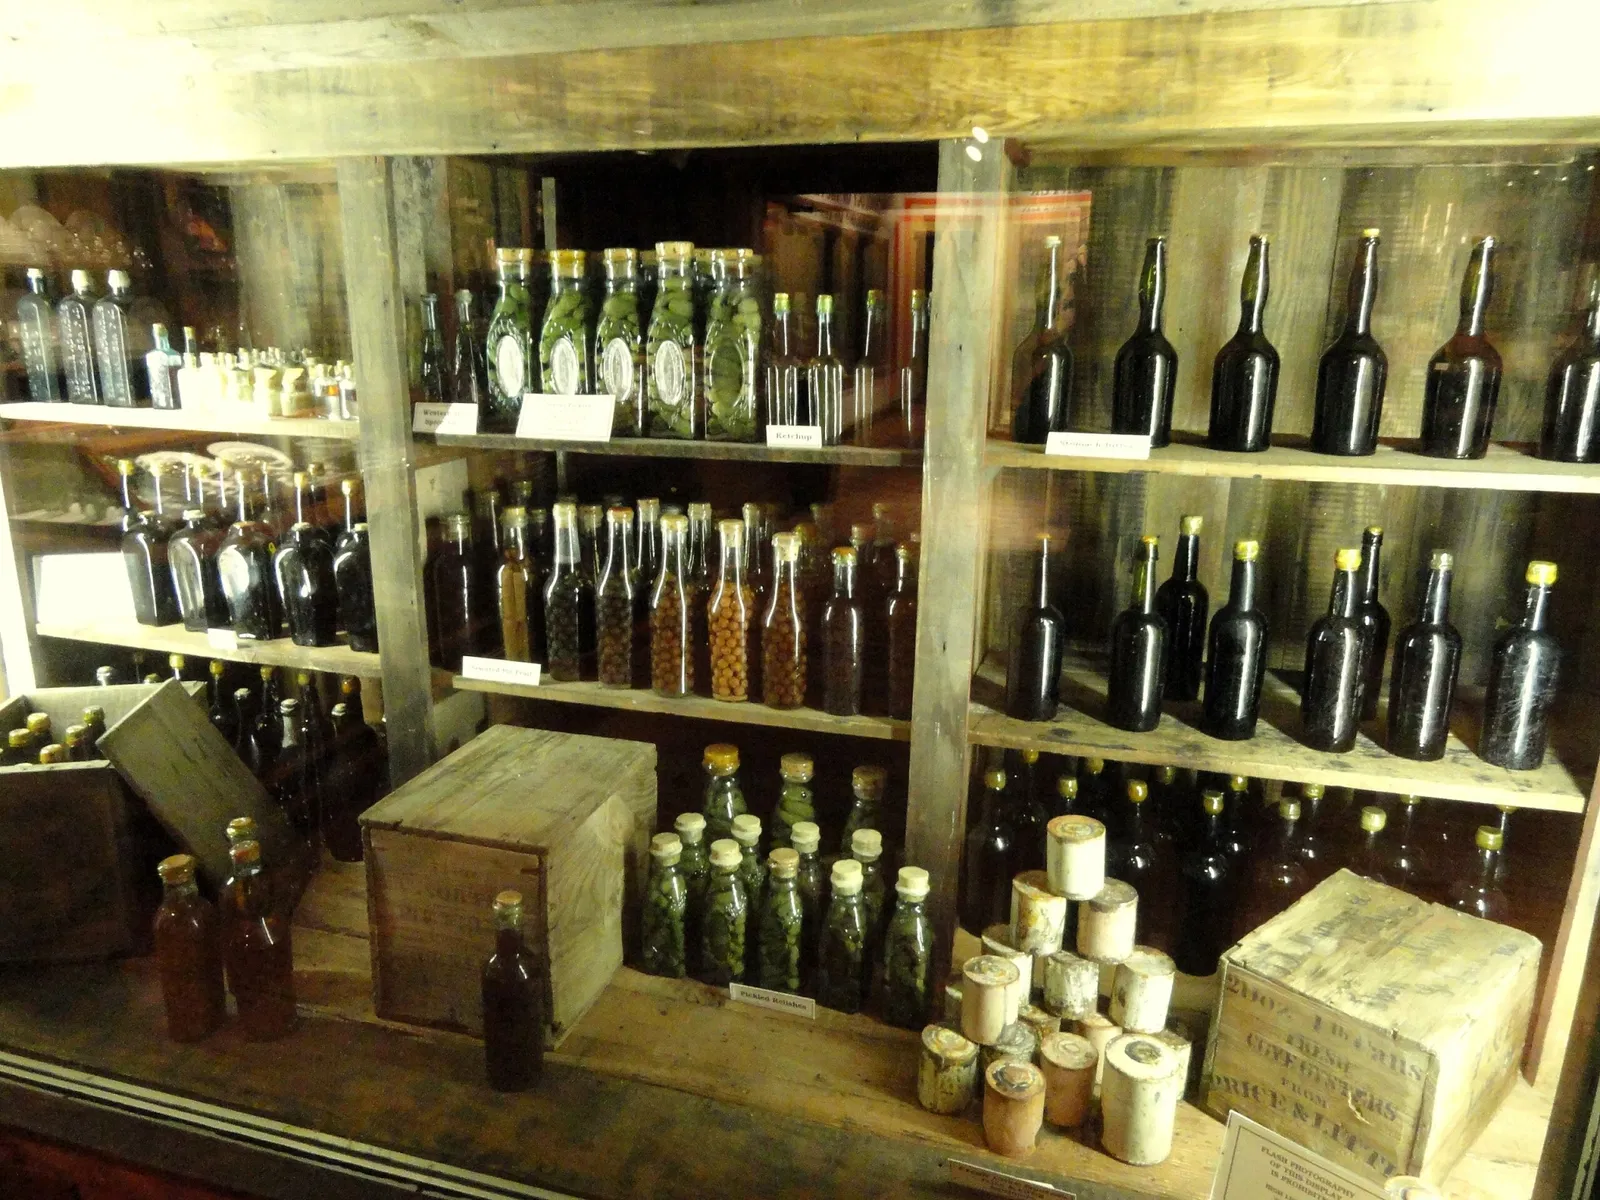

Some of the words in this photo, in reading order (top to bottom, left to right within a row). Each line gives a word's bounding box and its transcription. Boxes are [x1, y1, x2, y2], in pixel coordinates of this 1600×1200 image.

[740, 990, 771, 1002] Pickled
[1281, 1076, 1329, 1108] FROM
[1292, 1101, 1309, 1122] &
[1260, 1145, 1289, 1164] FLASH
[1289, 1161, 1356, 1199] PHOTOGRAPHY
[1269, 1159, 1282, 1170] OF
[1283, 1167, 1304, 1182] THIS
[1305, 1178, 1343, 1200] DISPLAY
[1270, 1169, 1280, 1179] IS
